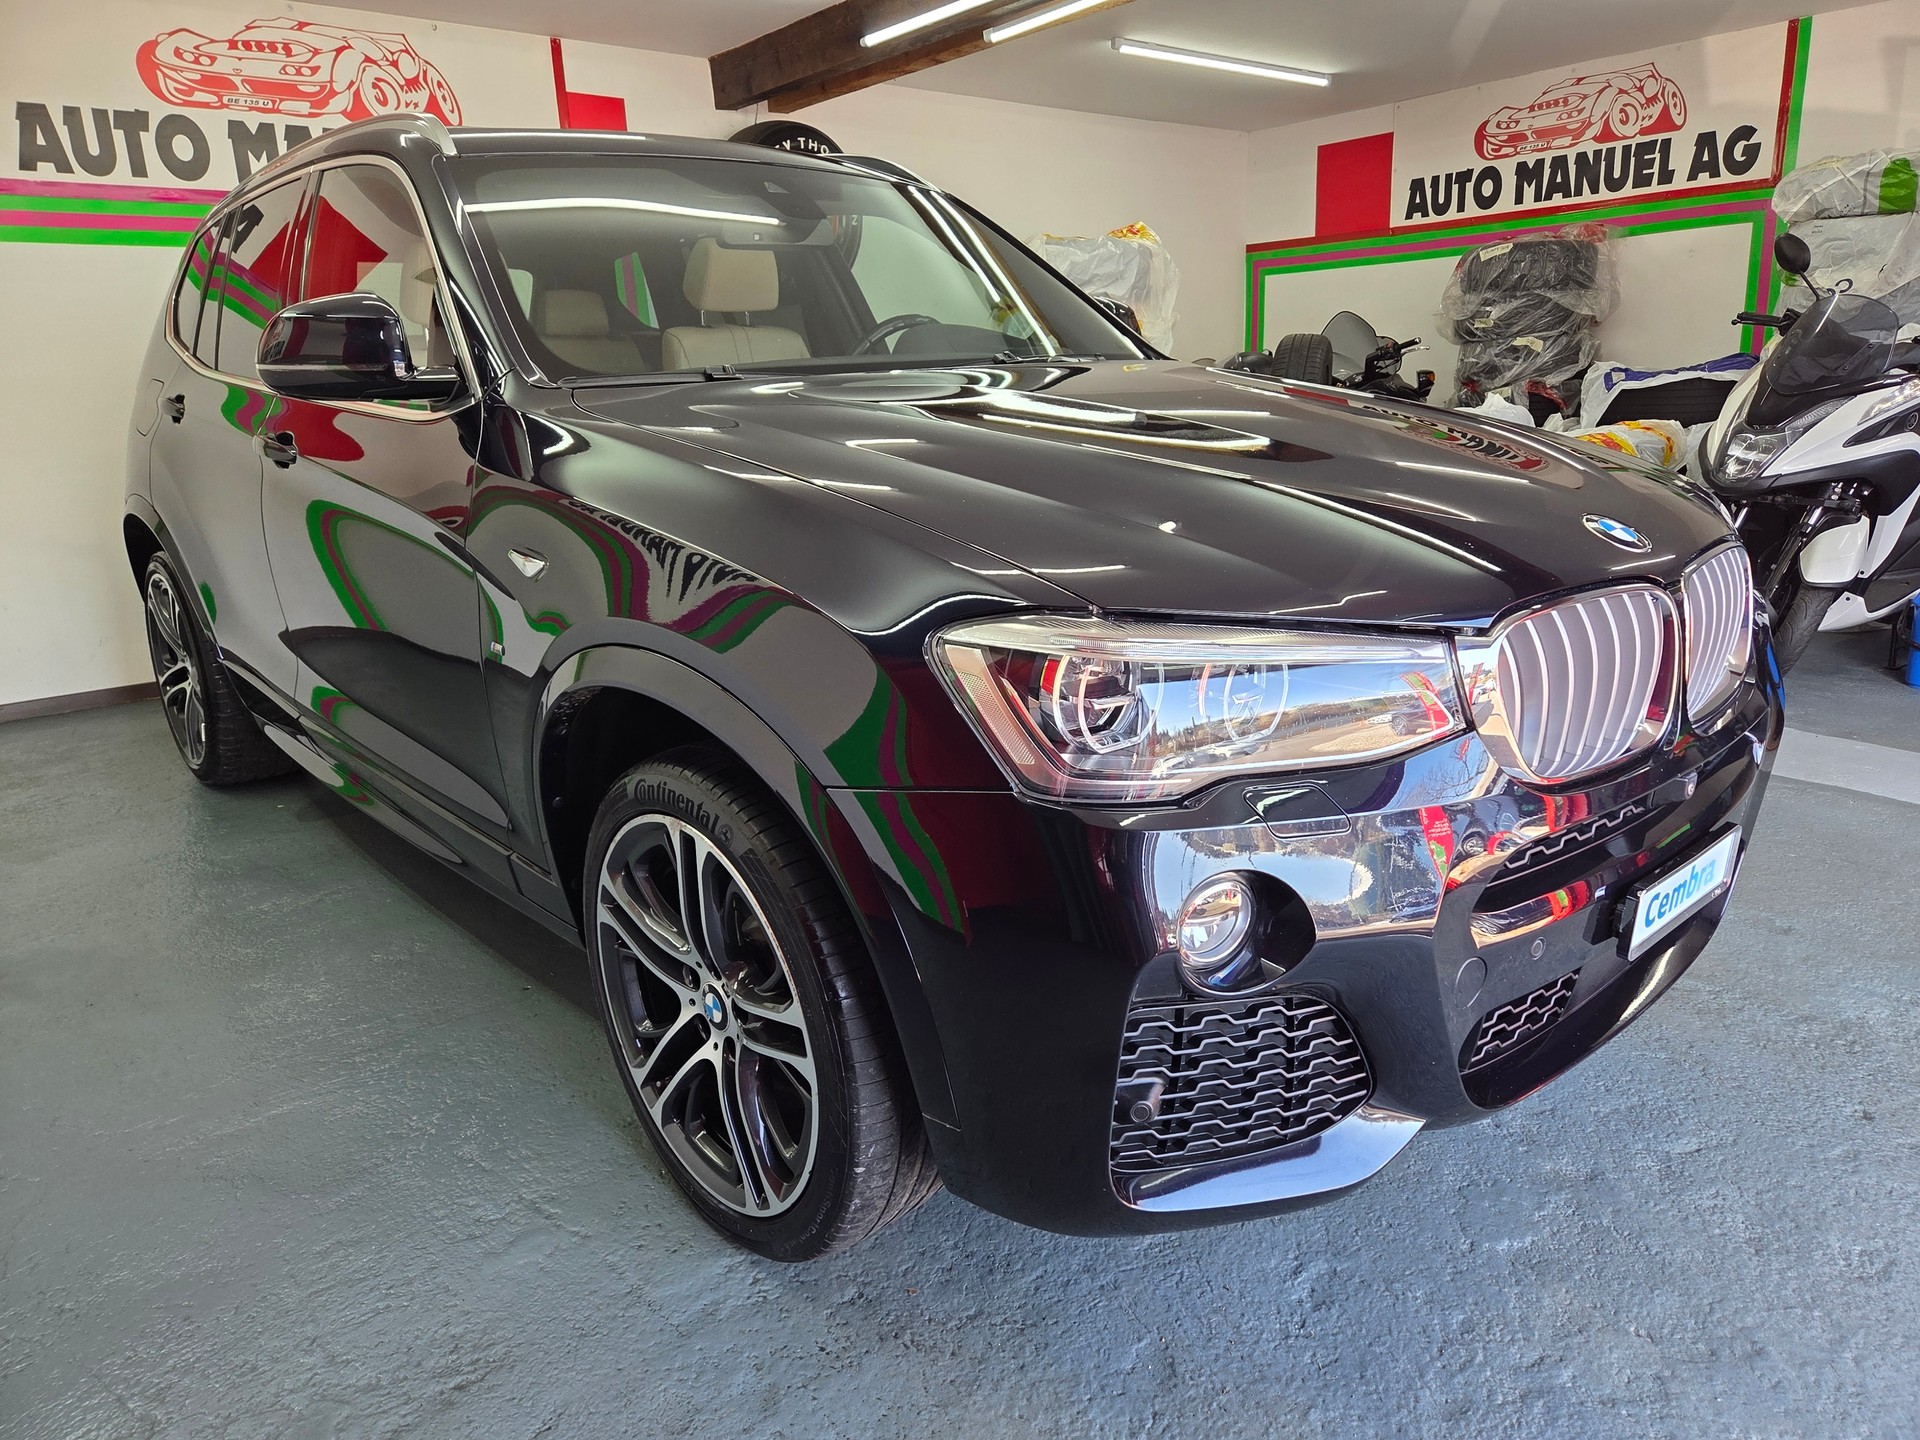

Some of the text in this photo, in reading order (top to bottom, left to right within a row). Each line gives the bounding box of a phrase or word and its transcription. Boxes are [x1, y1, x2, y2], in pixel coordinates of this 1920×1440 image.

[16, 101, 210, 182] AUTO
[1405, 124, 1762, 220] AUTO MANUEL AG
[634, 778, 720, 834] Continental
[1645, 859, 1716, 928] Cembra
